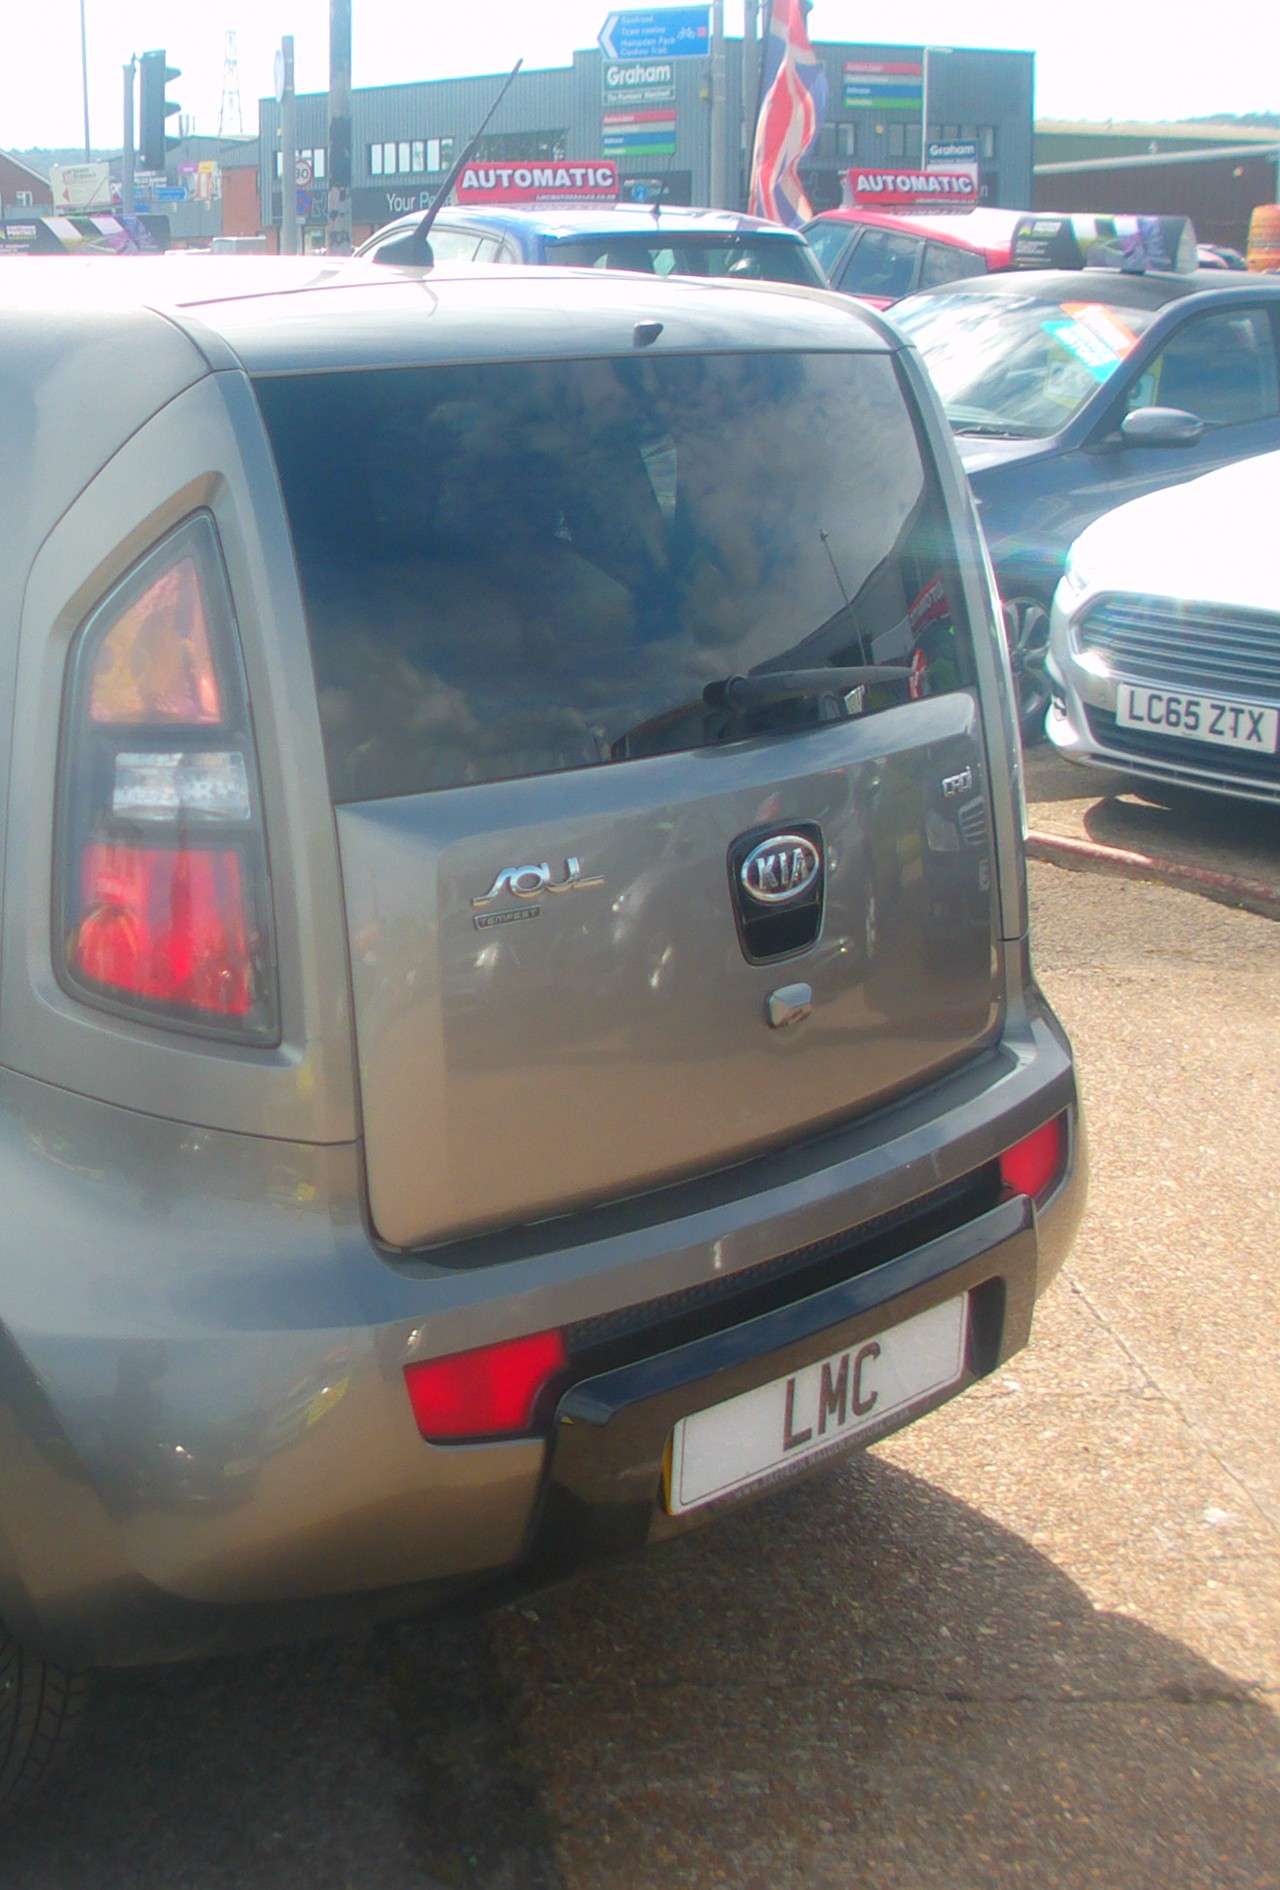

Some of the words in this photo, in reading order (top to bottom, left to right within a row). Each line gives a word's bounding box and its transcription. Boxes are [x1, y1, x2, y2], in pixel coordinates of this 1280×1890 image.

[606, 64, 672, 86] Graham
[929, 144, 975, 156] Graham
[462, 168, 614, 189] AUTOMATIC
[856, 174, 972, 193] AUTOMATIC
[385, 191, 417, 213] Your
[1128, 690, 1200, 731] LC65
[1209, 703, 1264, 743] ZTX
[755, 846, 813, 891] KIA
[783, 1341, 881, 1452] LMC
